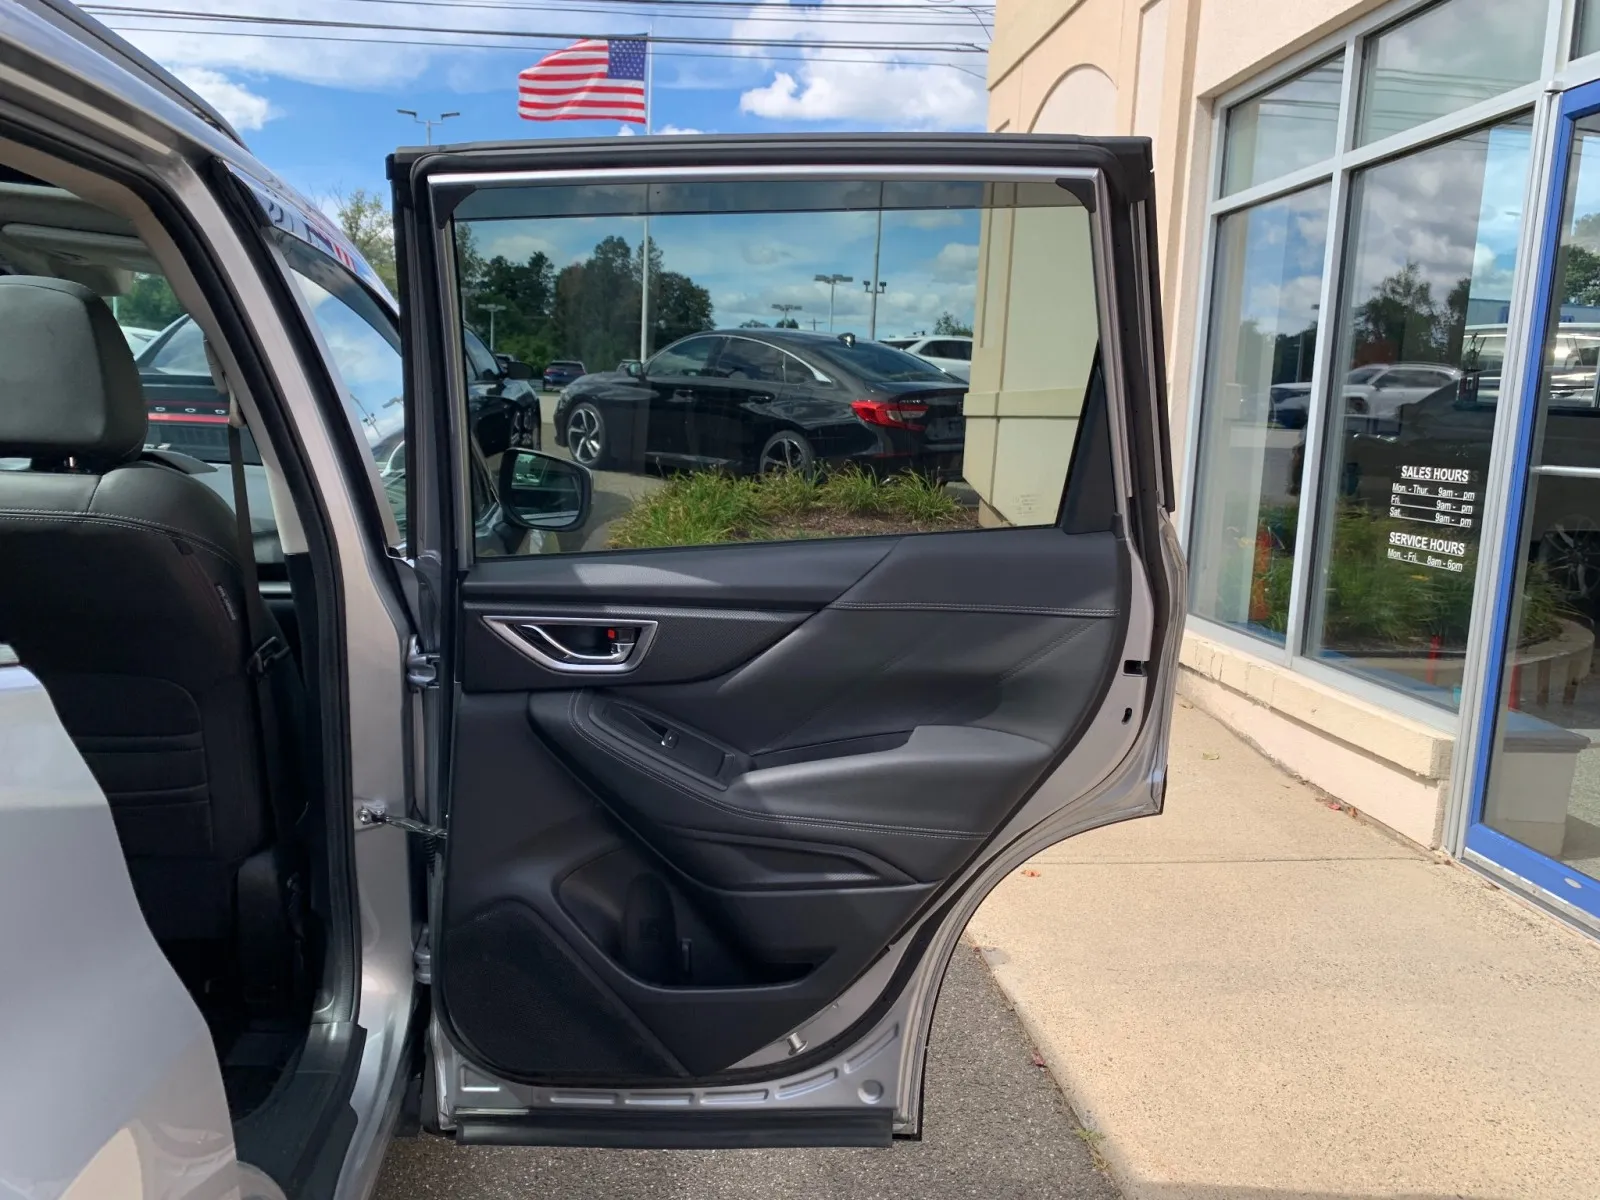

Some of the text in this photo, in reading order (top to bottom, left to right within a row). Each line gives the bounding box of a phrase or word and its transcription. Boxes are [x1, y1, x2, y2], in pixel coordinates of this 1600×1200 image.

[1401, 465, 1469, 482] SALES HOURS
[1413, 484, 1428, 495] Thur.
[1438, 487, 1453, 497] 9am
[1463, 491, 1475, 501] pm
[1391, 494, 1400, 505] Fri.
[1436, 499, 1451, 510] 9am
[1461, 504, 1473, 514] pm
[1389, 506, 1401, 517] Sat.
[1435, 512, 1450, 523] 9am
[1459, 517, 1472, 527] pm
[1389, 531, 1465, 555] SERVICE HOURS
[1387, 548, 1401, 558] Mon.
[1407, 552, 1417, 563] Fri.
[1426, 555, 1442, 566] 8am
[1447, 559, 1463, 571] 6pm
